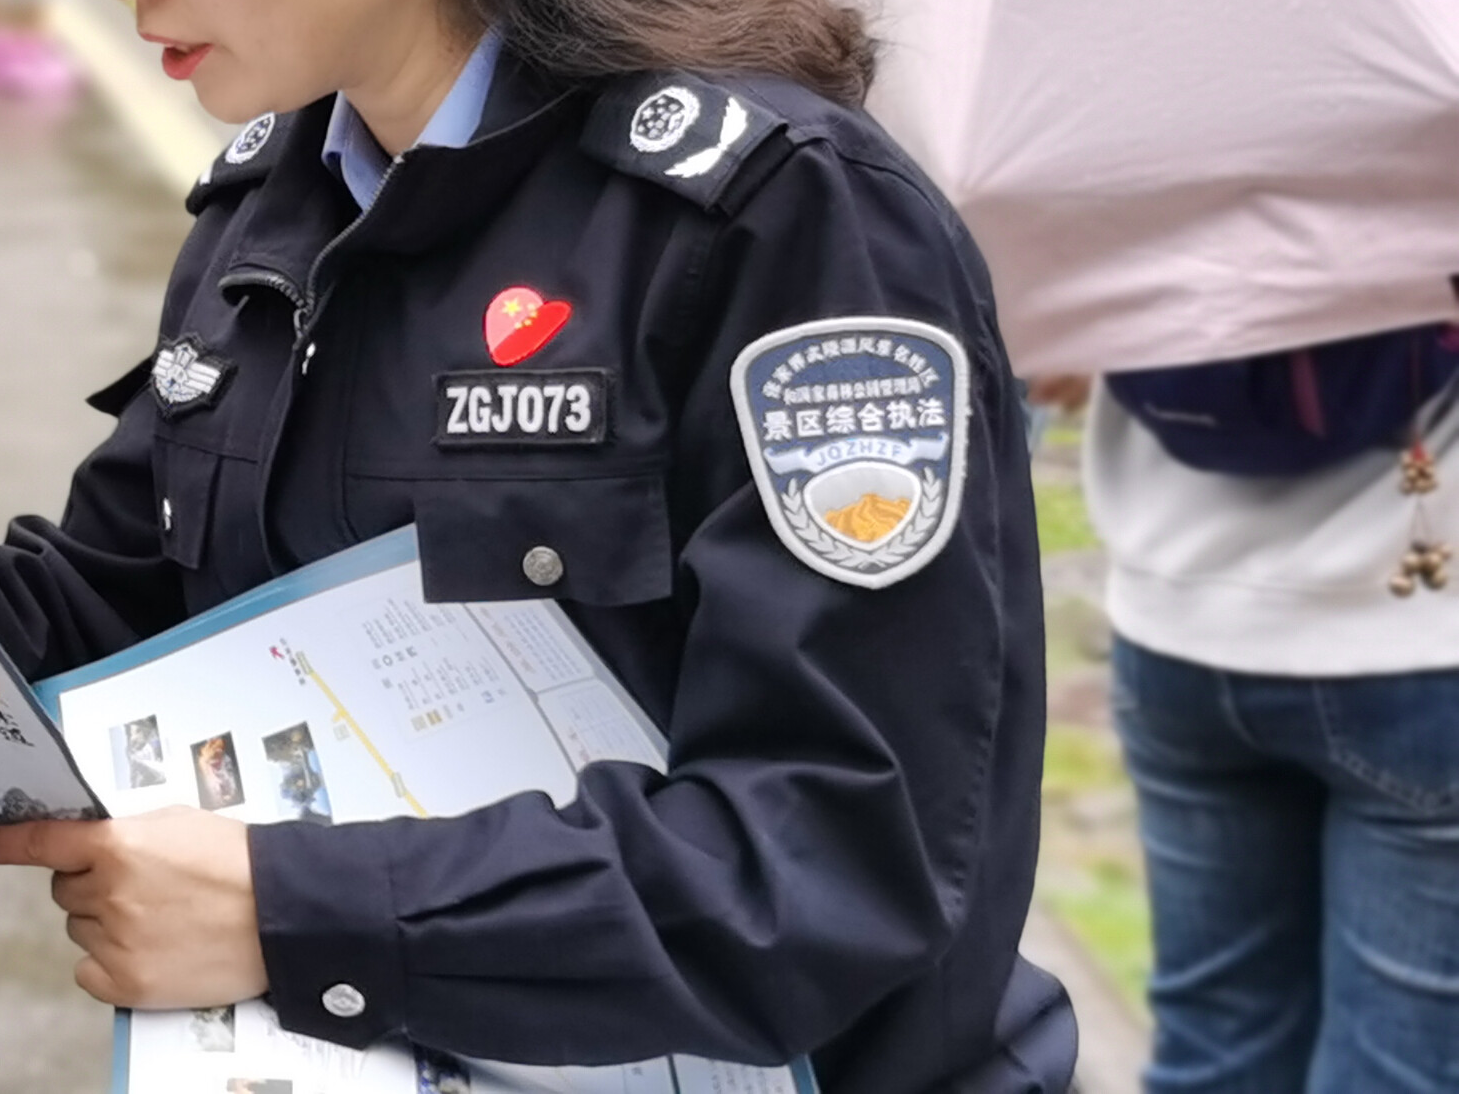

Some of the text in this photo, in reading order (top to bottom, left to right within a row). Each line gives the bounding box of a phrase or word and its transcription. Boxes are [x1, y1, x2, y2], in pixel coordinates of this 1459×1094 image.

[445, 385, 591, 435] ZGJ073
[764, 397, 945, 441] 景区综合执法
[817, 440, 903, 466] JQZHZF
